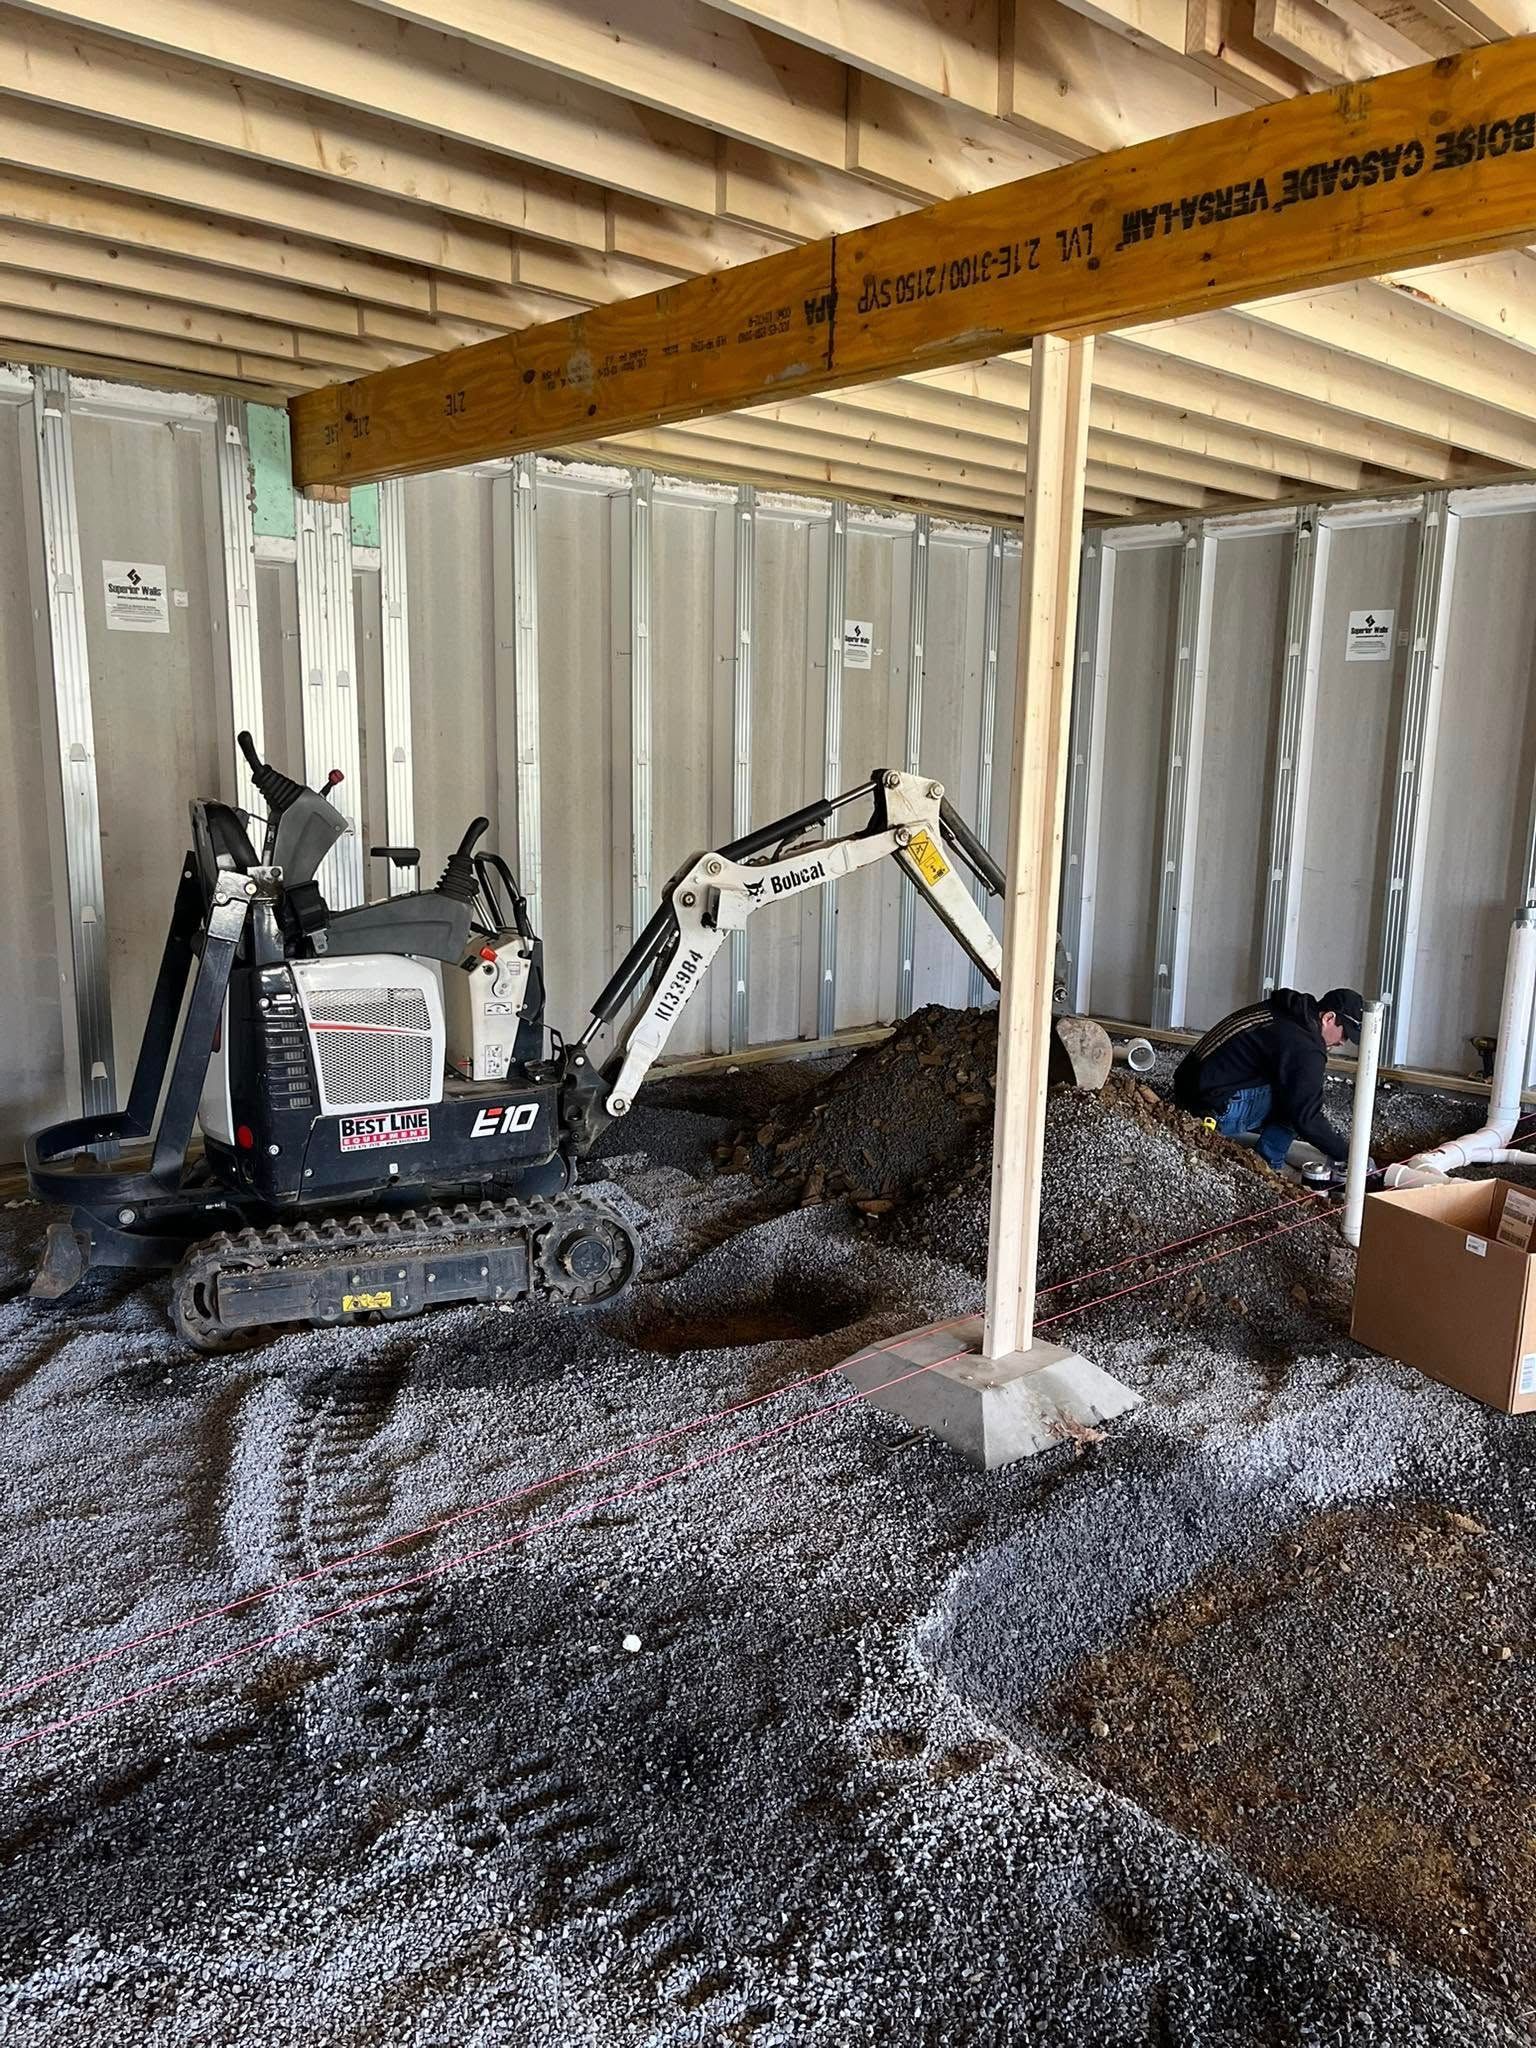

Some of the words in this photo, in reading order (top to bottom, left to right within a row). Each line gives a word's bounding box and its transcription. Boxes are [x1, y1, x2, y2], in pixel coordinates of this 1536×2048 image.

[1432, 111, 1536, 171] BOISE
[1056, 223, 1093, 262] LVL
[858, 274, 891, 314] SYP
[108, 583, 140, 594] Superior
[142, 586, 162, 596] Walls
[770, 861, 826, 894] Bobcat
[341, 1118, 386, 1137] BEST
[390, 1113, 427, 1131] LINE
[343, 1130, 426, 1145] EQUIPMENT
[470, 1103, 540, 1138] E10
